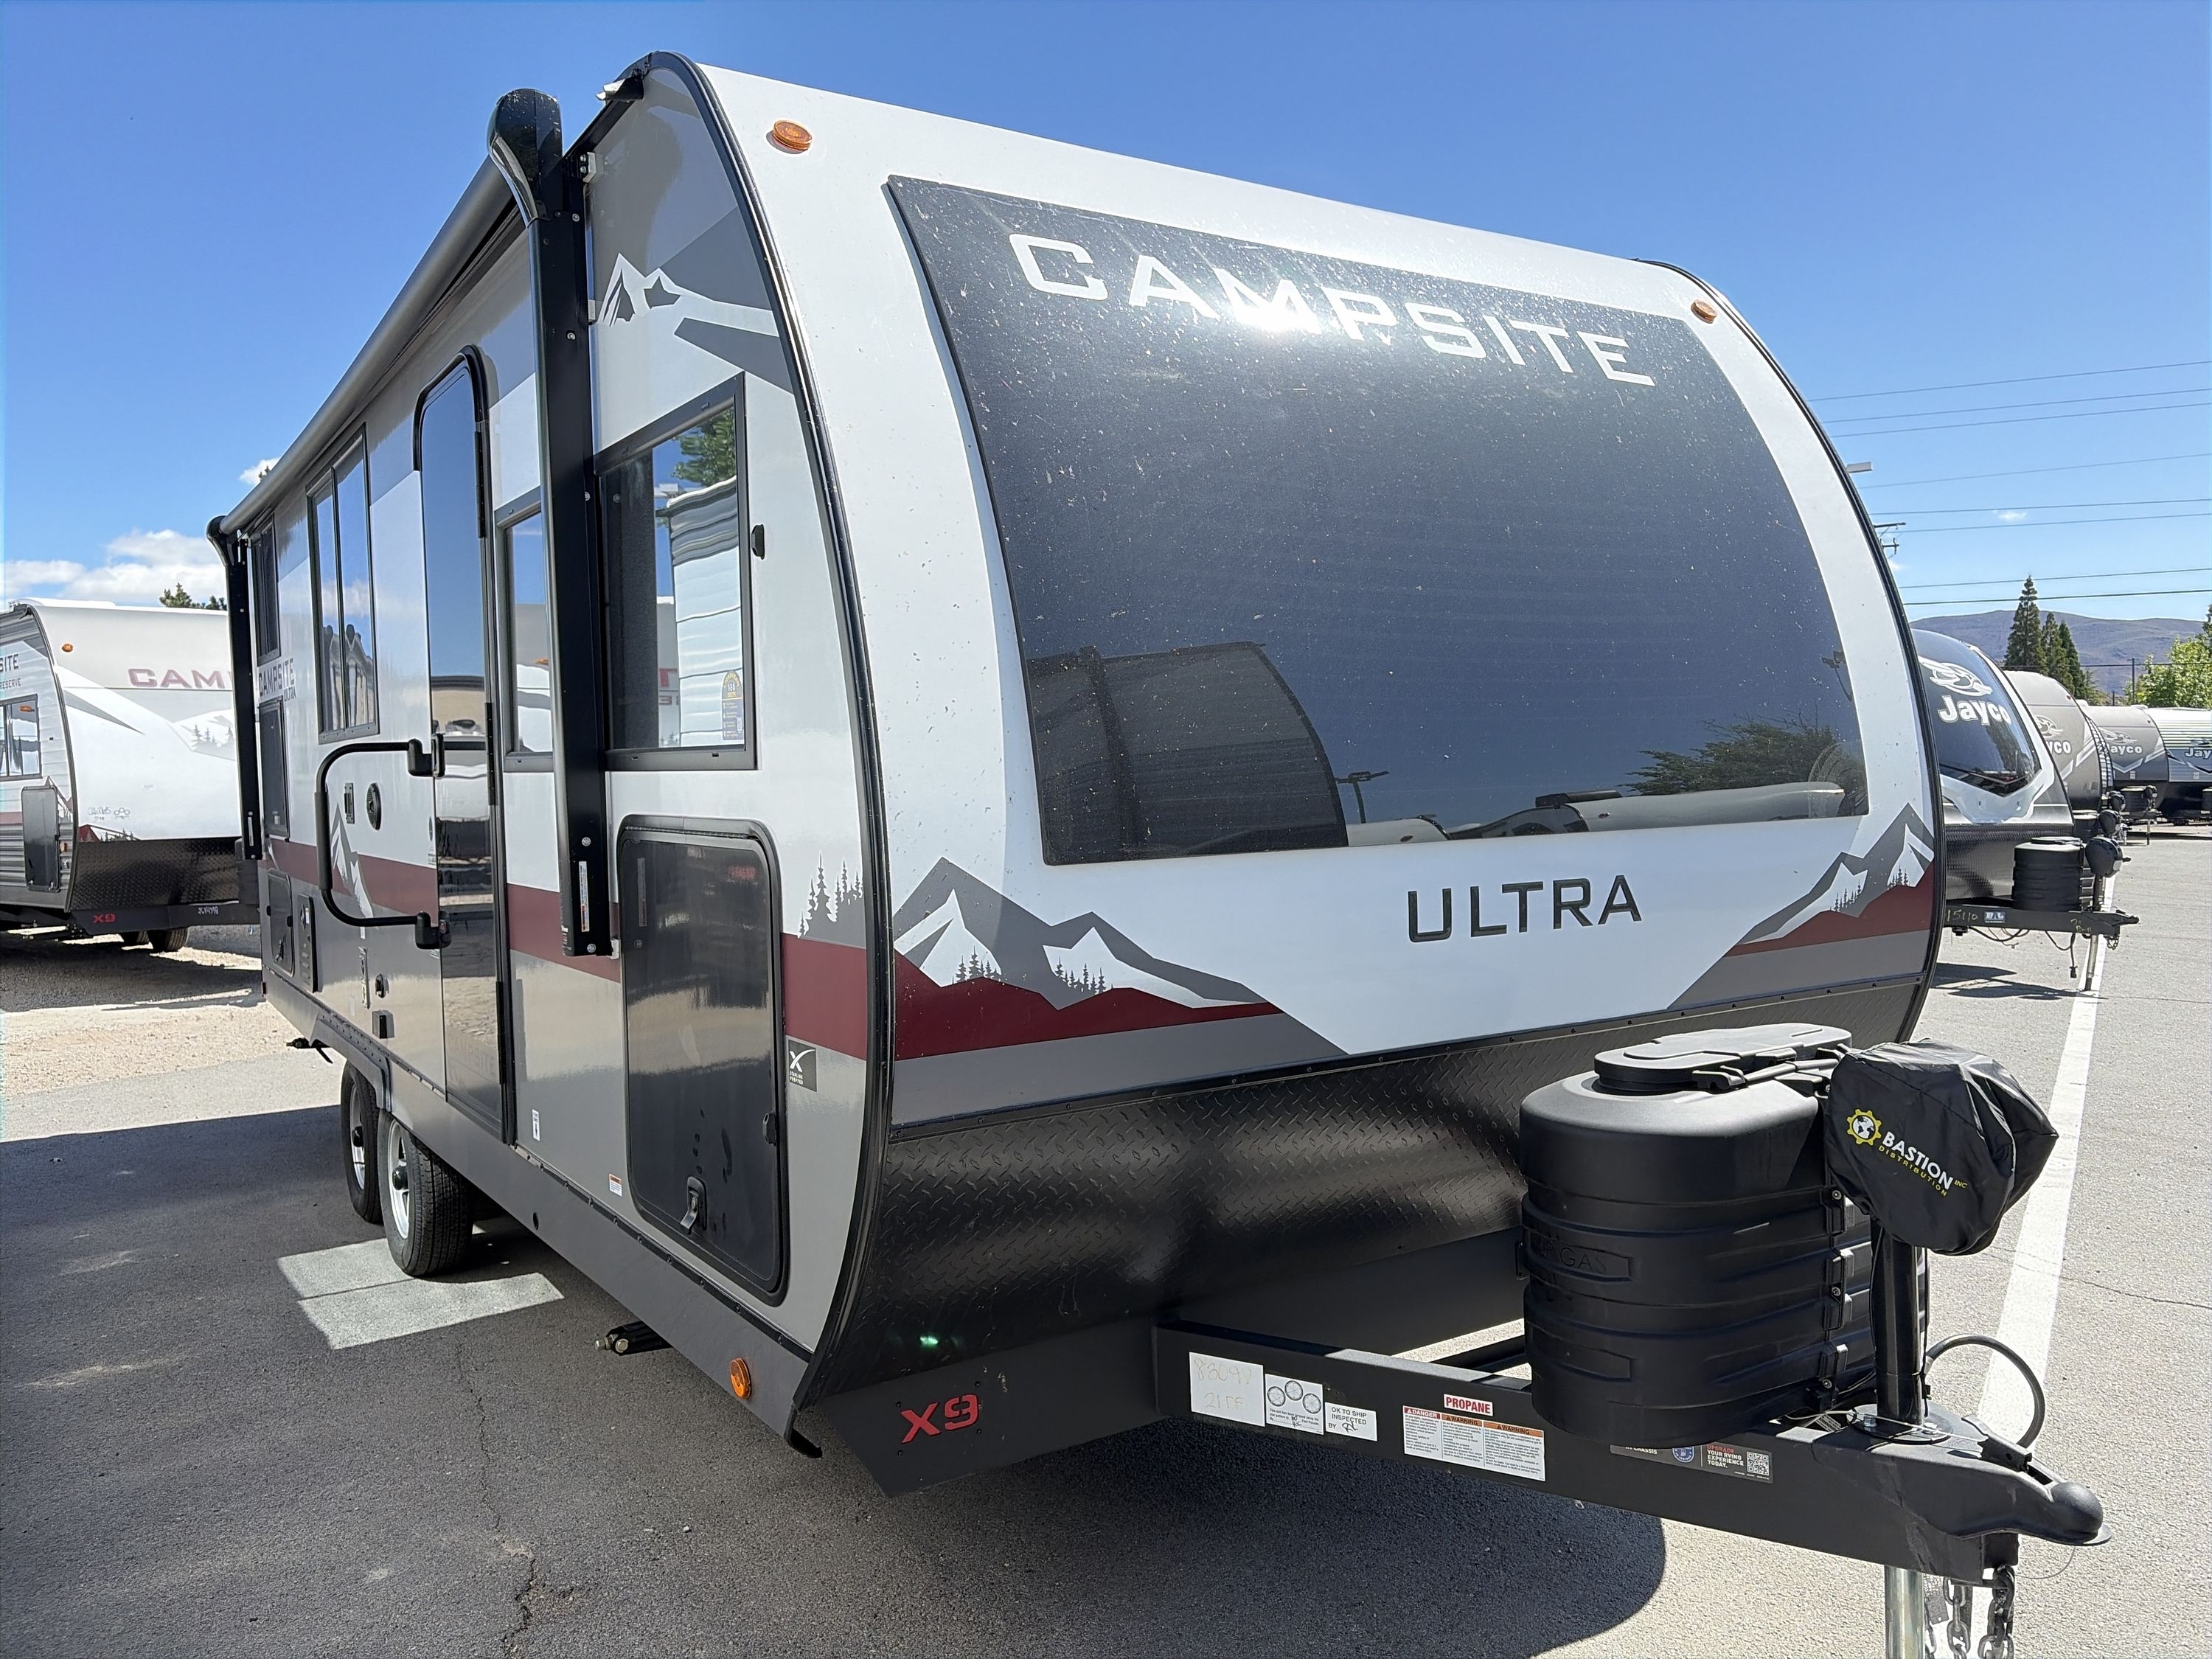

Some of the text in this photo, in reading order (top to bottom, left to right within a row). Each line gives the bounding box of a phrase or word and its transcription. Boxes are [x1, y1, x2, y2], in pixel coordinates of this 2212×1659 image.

[1009, 233, 1655, 386] CAMPSITE
[128, 668, 233, 689] CAM
[259, 658, 295, 698] CAMPSITE
[1937, 695, 2012, 726] Jayco
[1408, 874, 1642, 943] ULTRA
[94, 914, 116, 923] X9
[1882, 1131, 1968, 1190] BASTION INC
[1878, 1145, 1947, 1197] DISTRIBUTION
[1559, 1247, 1607, 1274] GAS
[1412, 1408, 1438, 1419] DANGER
[1446, 1397, 1491, 1414] PROPANE
[900, 1394, 978, 1444] X9
[1332, 1413, 1367, 1425] INSPECTED
[1451, 1416, 1478, 1425] WARNING
[1502, 1425, 1530, 1435] WARNING
[1707, 1444, 1735, 1454] UPGRADE
[1707, 1455, 1745, 1467] EXPERIENCE
[1707, 1460, 1728, 1469] TODAY.
